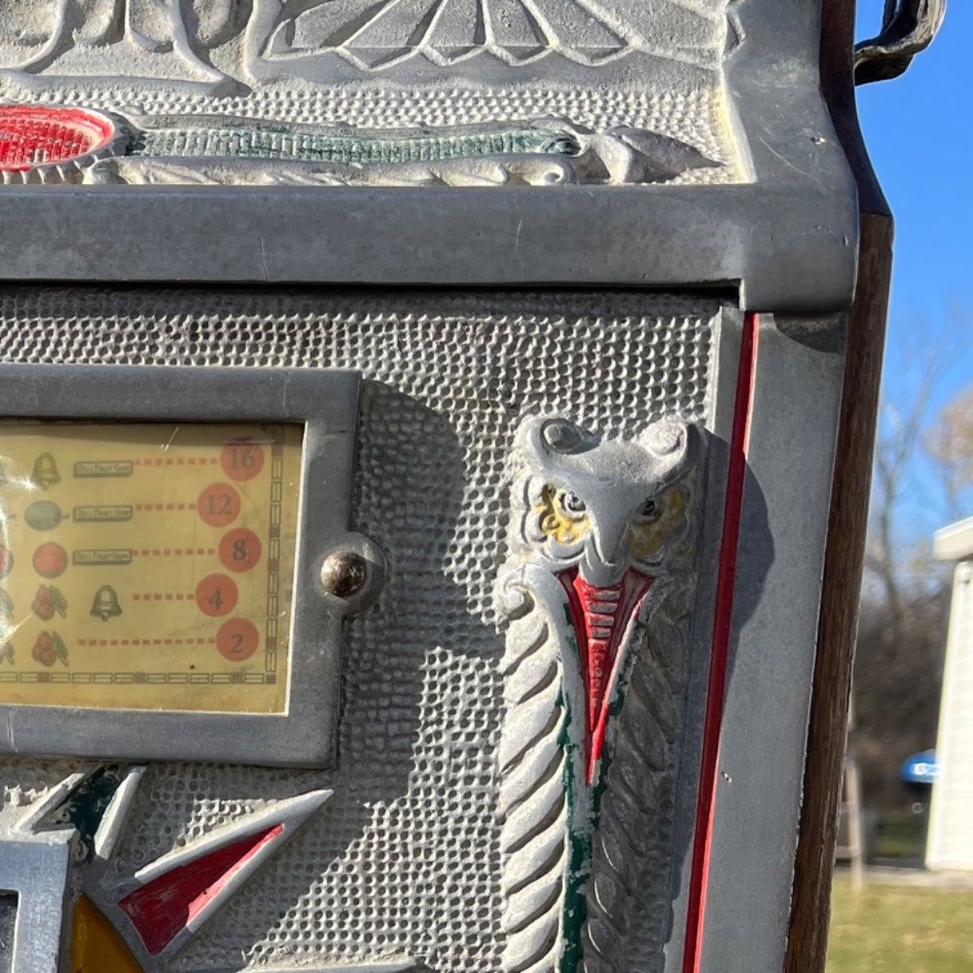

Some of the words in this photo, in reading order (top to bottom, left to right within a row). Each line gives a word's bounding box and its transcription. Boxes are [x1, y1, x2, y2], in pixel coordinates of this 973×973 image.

[228, 448, 256, 471] 16
[206, 493, 233, 517] 12
[231, 538, 247, 561] 8
[208, 587, 224, 611] 4
[229, 633, 245, 654] 2
